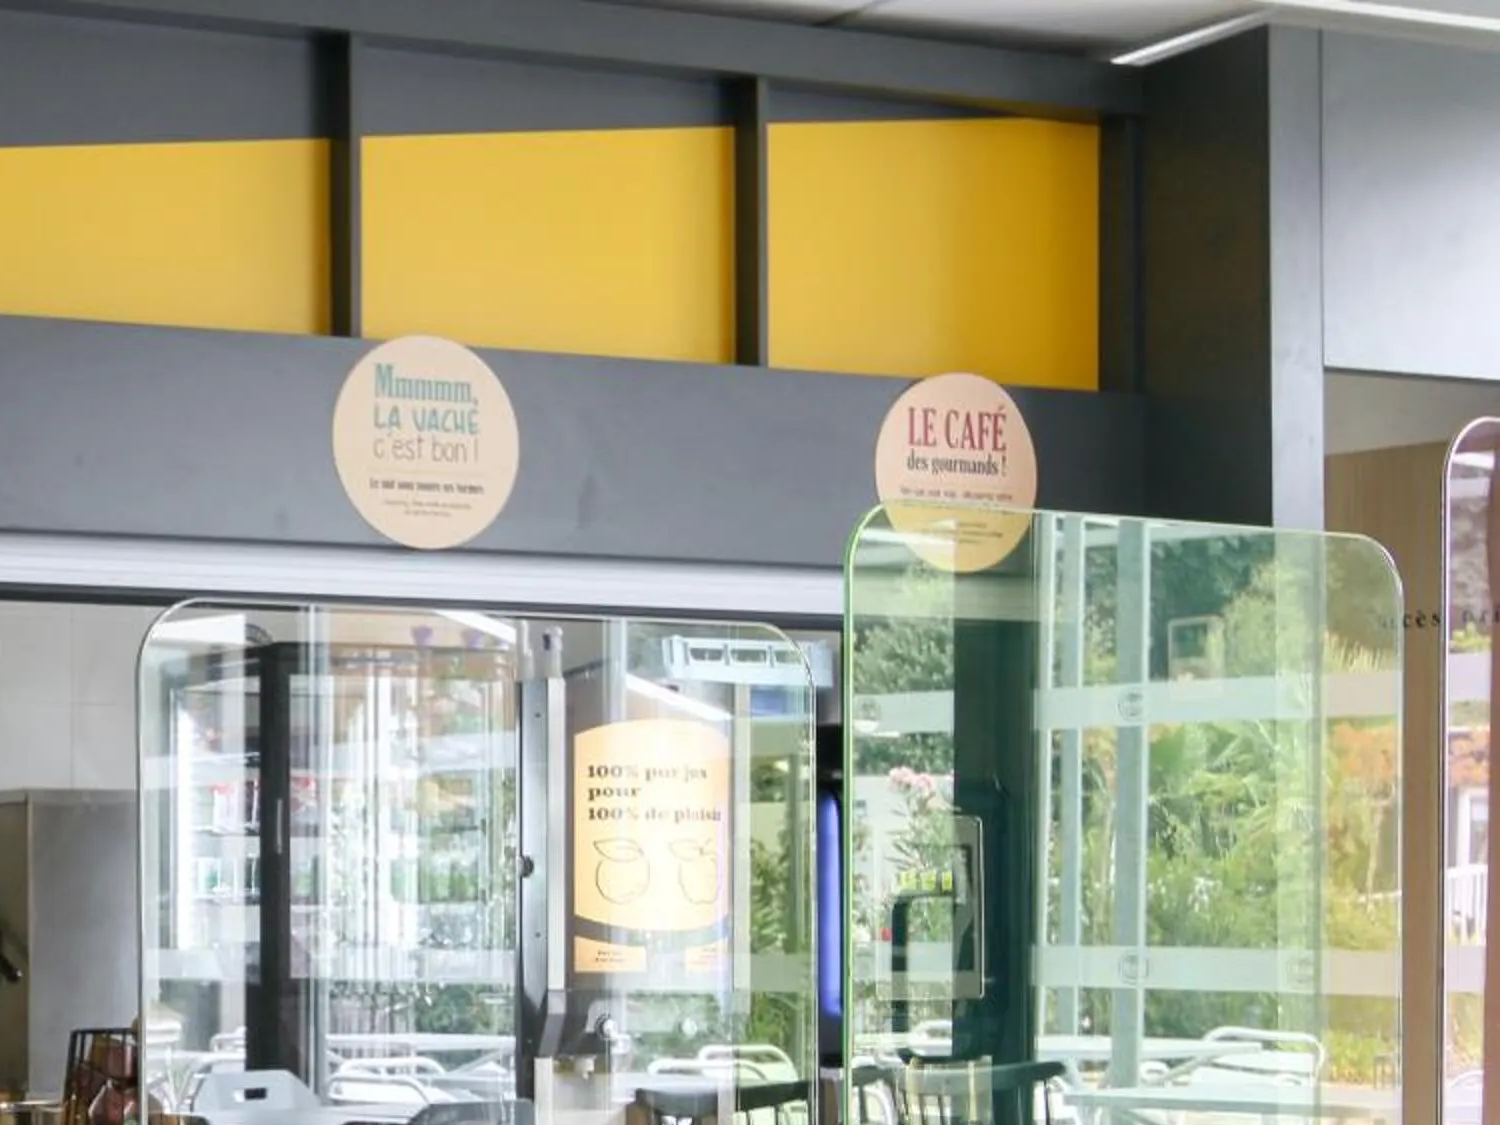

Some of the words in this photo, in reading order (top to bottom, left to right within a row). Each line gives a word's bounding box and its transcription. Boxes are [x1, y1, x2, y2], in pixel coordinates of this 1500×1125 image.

[373, 403, 402, 431] LA
[412, 406, 480, 436] VACHE
[908, 407, 938, 448] LE
[945, 405, 1007, 452] CAFÉ
[431, 433, 468, 463] bon
[907, 449, 929, 472] des
[932, 453, 999, 476] gourmands
[588, 764, 639, 779] 100%
[588, 786, 641, 802] pour
[588, 807, 639, 821] 100%
